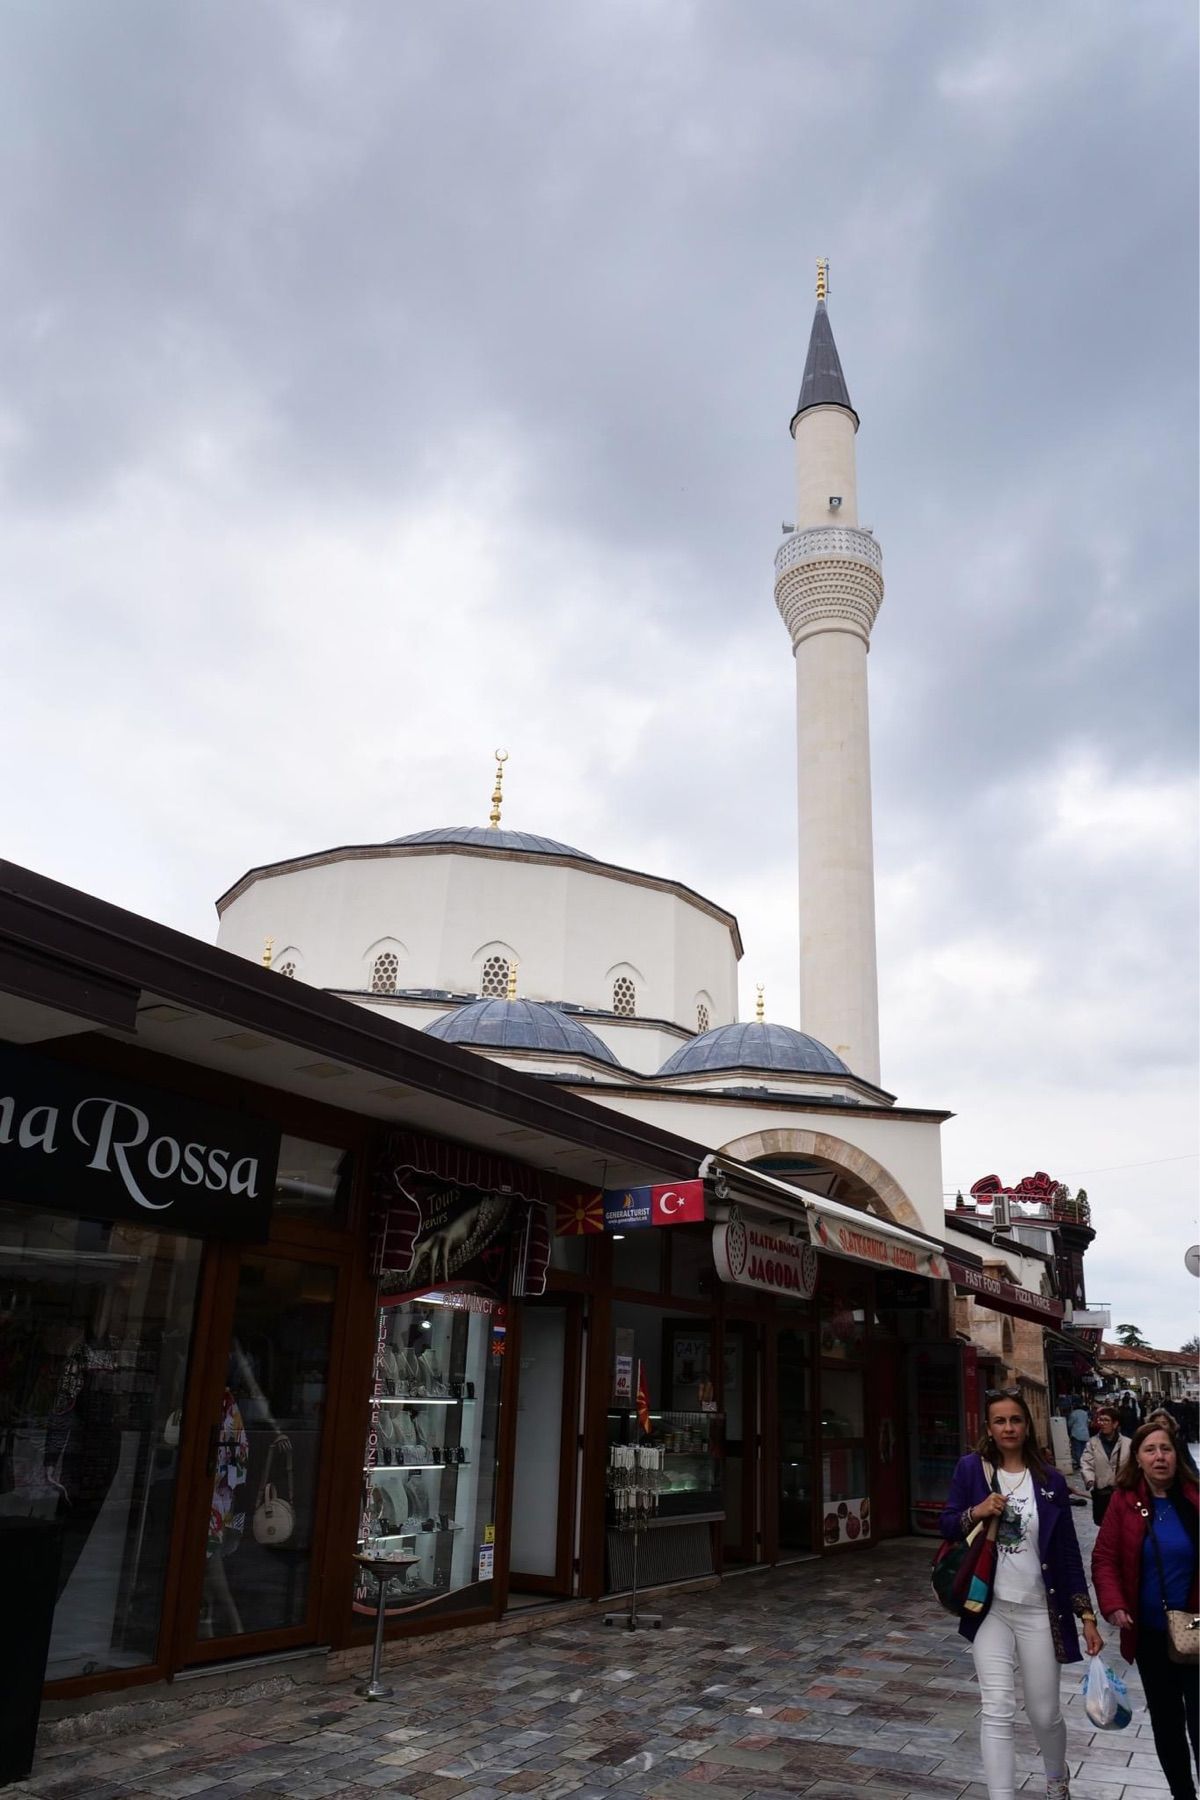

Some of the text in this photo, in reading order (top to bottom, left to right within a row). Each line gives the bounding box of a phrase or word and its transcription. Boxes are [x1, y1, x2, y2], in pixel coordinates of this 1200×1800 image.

[72, 1097, 259, 1210] Rossa
[426, 1190, 462, 1215] Tours
[606, 1208, 650, 1219] GENERALTURIST
[749, 1230, 800, 1258] SLATKARNICA
[839, 1228, 917, 1271] SLATKARNICA JAGODA
[748, 1255, 801, 1291] JAGODA
[965, 1270, 982, 1288] FAST
[983, 1277, 1001, 1294] FOOD
[1015, 1288, 1032, 1304] PIZZA
